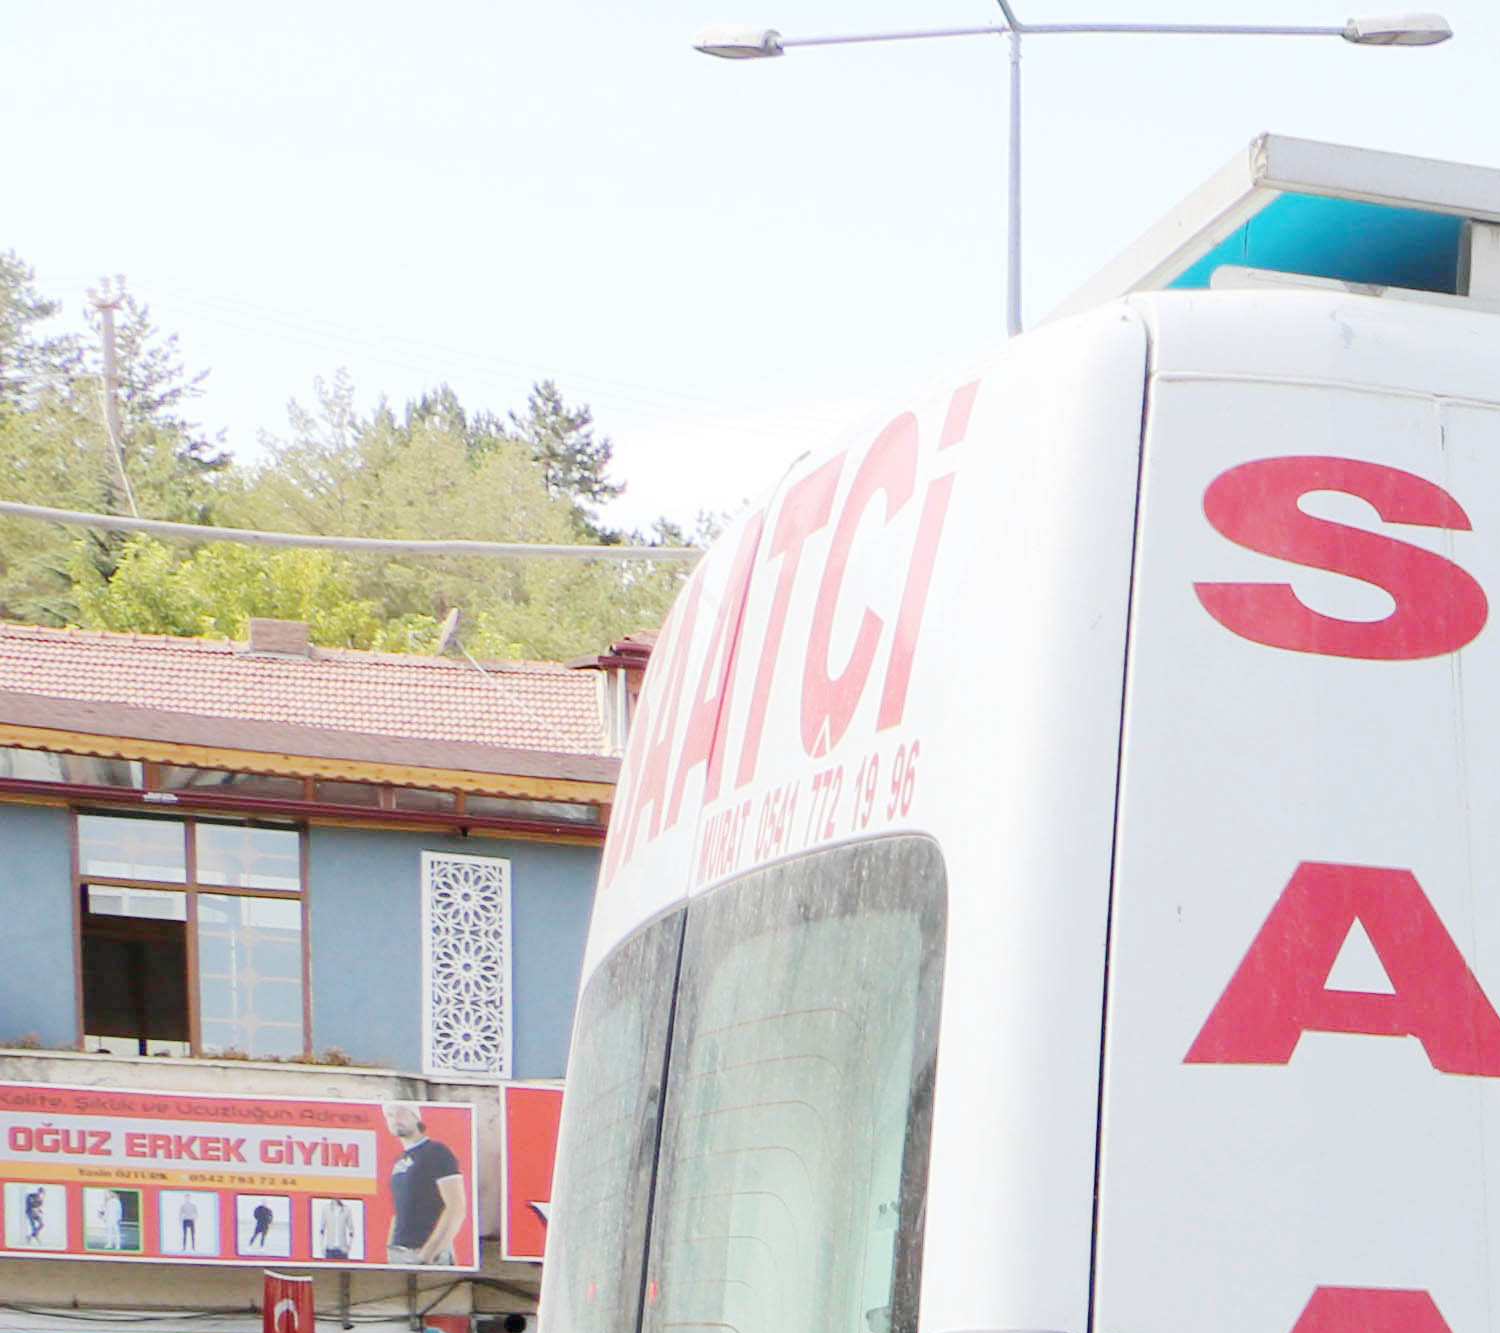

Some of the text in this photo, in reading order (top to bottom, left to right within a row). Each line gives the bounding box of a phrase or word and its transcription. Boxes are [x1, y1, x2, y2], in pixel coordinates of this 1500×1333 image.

[804, 764, 843, 847] 772
[852, 752, 879, 830] 19
[887, 739, 920, 821] 96
[8, 1122, 359, 1168] OĞUZ ERKEK GİYİM
